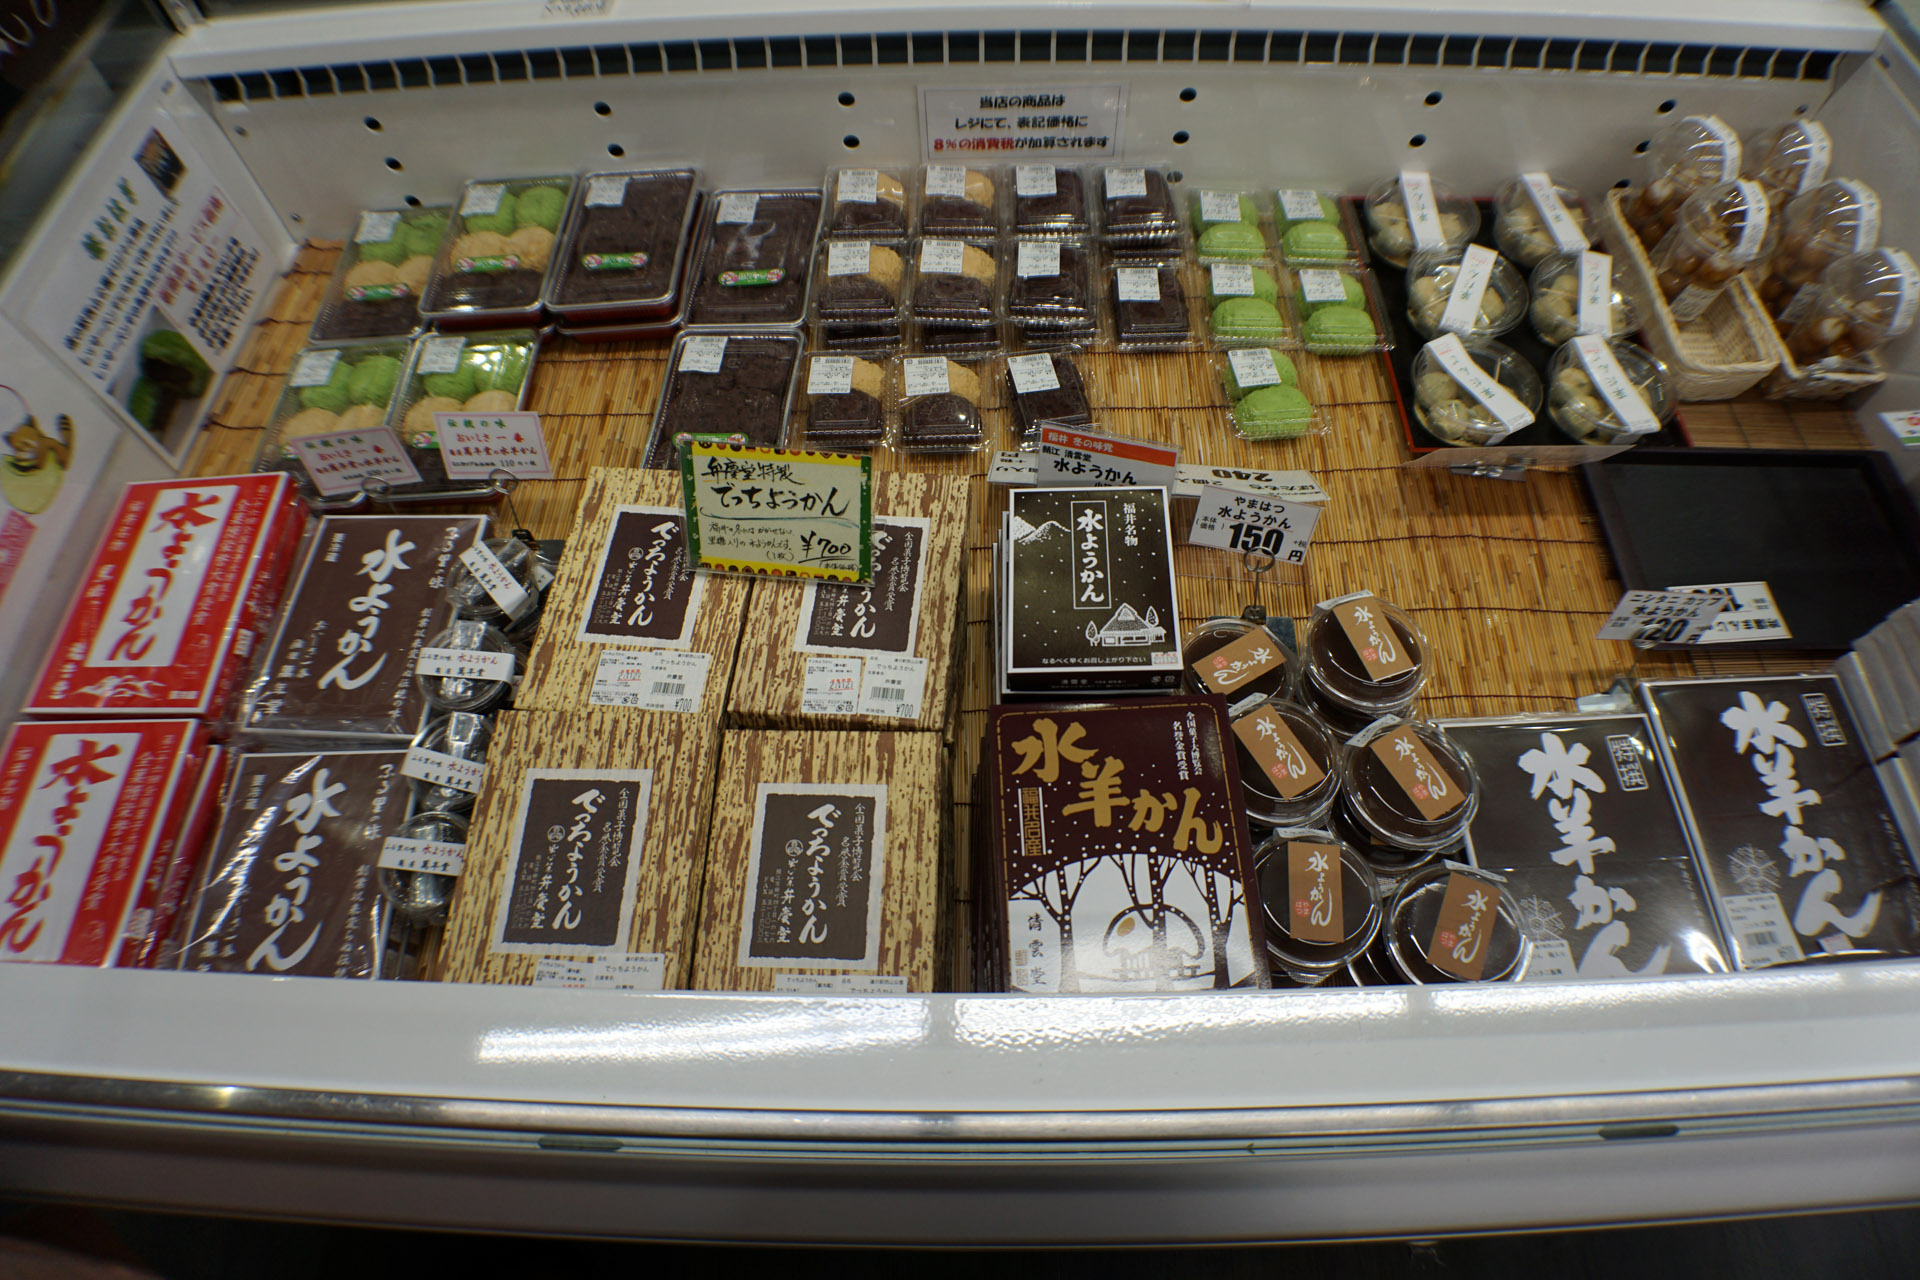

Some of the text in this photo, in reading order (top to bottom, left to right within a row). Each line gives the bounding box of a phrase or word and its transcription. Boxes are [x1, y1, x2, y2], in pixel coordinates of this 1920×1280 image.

[980, 94, 1065, 109] 当店の商品は
[955, 116, 1088, 129] レジにて、表記価格に
[1042, 446, 1092, 462] 鯖江 清雲堂
[1048, 432, 1113, 452] 福井 冬の味覚
[701, 456, 805, 485] 弁慶堂特製
[1054, 458, 1136, 485] 水ようかん
[1212, 469, 1273, 482] 240
[711, 483, 851, 516] でっちようかん
[1235, 496, 1285, 513] やまはつ
[1123, 503, 1138, 547] 福井名物
[1218, 506, 1291, 529] 水ようかん
[801, 531, 852, 558] ¥700
[1076, 508, 1105, 603] 水ようかん
[1229, 523, 1284, 556] 150
[1288, 550, 1303, 562] 円
[107, 491, 221, 662] 水ようかん
[628, 521, 680, 627] でっちようかん
[317, 528, 417, 691] 水ようかん
[1629, 594, 1724, 607] ニシタニ カップ
[1632, 606, 1701, 617] 水ようかん
[1353, 606, 1397, 665] 水ようかん
[458, 654, 499, 666] 水ようかん
[659, 659, 697, 667] でっちようかん
[876, 663, 915, 672] でっちようかん
[1213, 648, 1272, 684] 水ようかん
[674, 698, 693, 712] ¥700
[896, 703, 914, 717] ¥700
[1172, 720, 1189, 781] 名誉金賞受賞
[1255, 715, 1307, 780] 水ようかん
[1394, 736, 1447, 801] 水ようかん
[1011, 717, 1223, 855] 水羊かん
[1719, 690, 1882, 939] 水羊かん
[0, 739, 121, 953] 水ようかん
[552, 788, 606, 930] でっちようかん
[1516, 732, 1672, 976] 水羊かん
[246, 768, 347, 972] 水ようかん
[799, 804, 841, 945] でっちようかん
[1305, 850, 1334, 928] 水ようかん
[1452, 889, 1489, 964] 水ようかん
[1027, 912, 1047, 986] 清雲堂
[604, 965, 649, 974] でっちようかん
